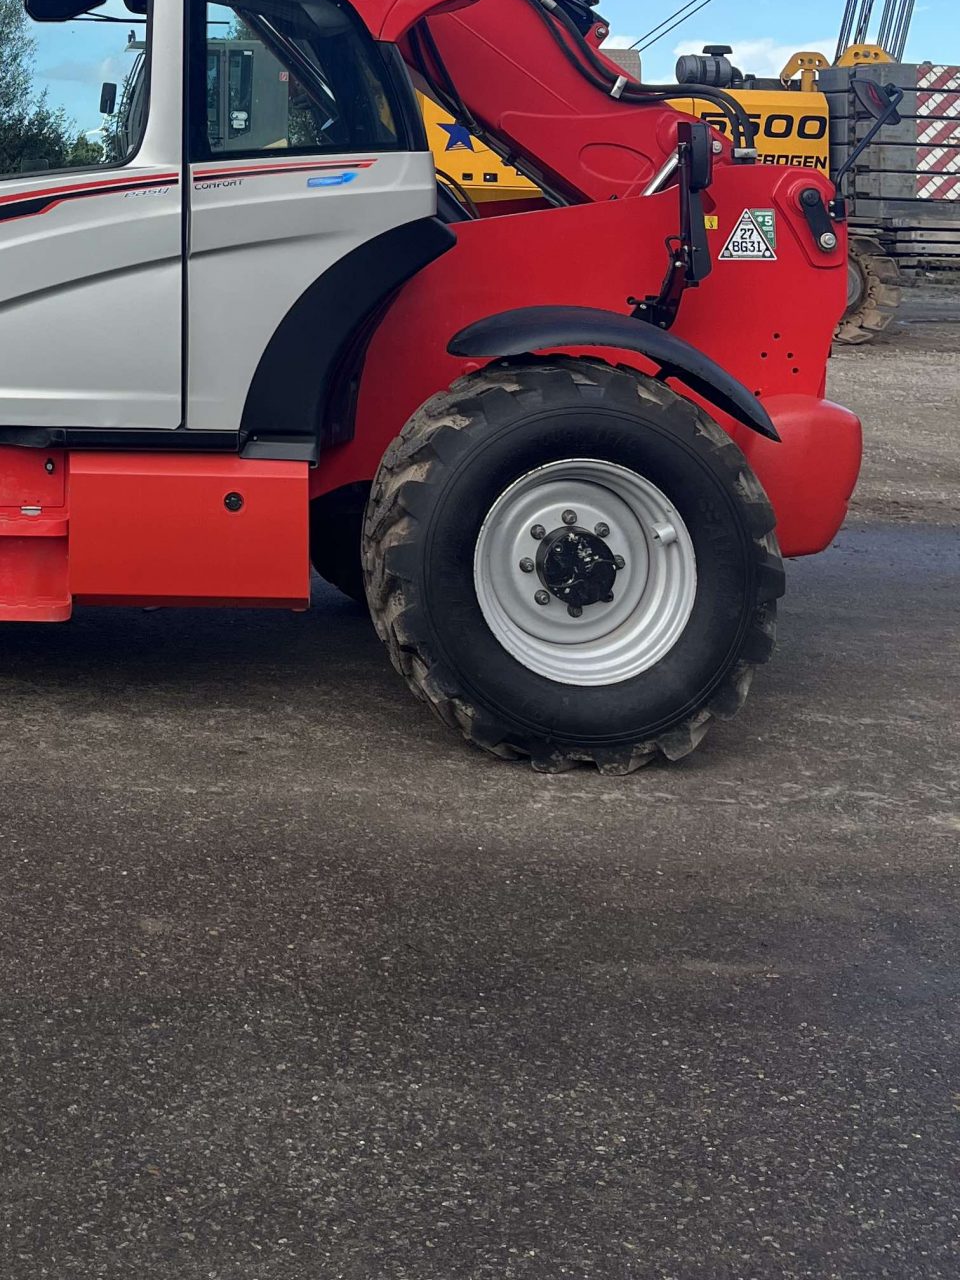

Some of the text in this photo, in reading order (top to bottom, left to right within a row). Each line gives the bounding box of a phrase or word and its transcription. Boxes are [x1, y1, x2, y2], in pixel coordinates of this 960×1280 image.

[764, 215, 773, 226] 5
[740, 228, 754, 240] 27
[732, 240, 762, 253] BG31
